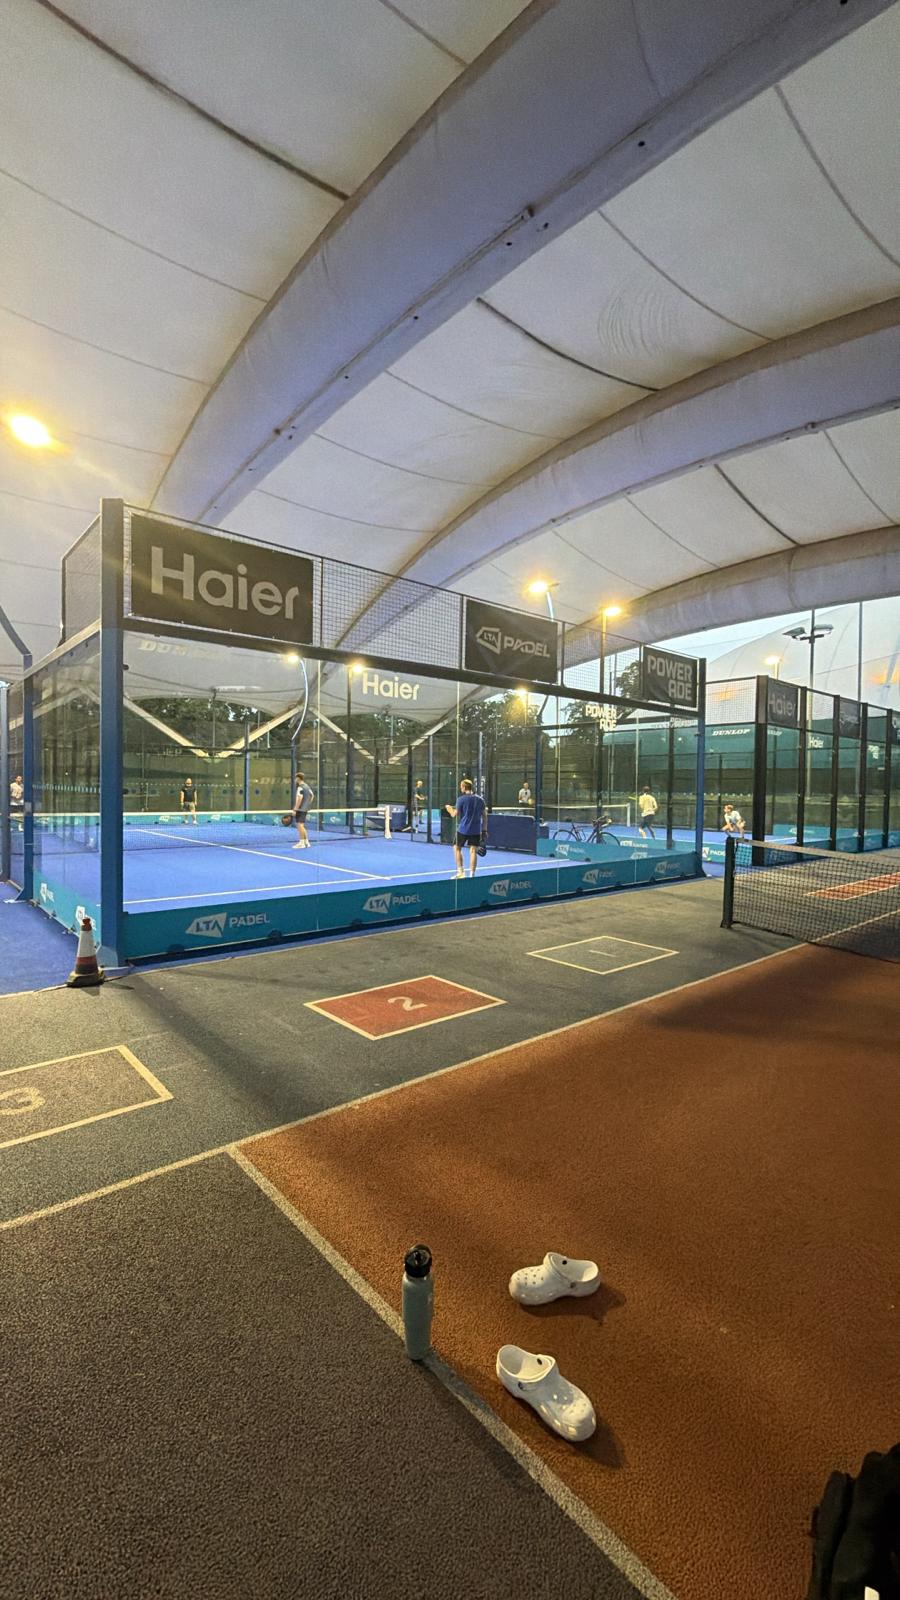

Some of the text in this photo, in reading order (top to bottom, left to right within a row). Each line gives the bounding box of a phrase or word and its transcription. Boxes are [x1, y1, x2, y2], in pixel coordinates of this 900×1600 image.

[151, 546, 299, 619] Haier
[503, 635, 551, 658] PADEL
[647, 654, 693, 681] POWER
[362, 671, 420, 701] Haier
[668, 679, 693, 700] ADE
[585, 704, 617, 720] POWER
[599, 719, 617, 731] ADE
[712, 728, 751, 737] DUNLOP
[392, 894, 422, 905] PADEL
[229, 912, 271, 928] PADEL
[387, 996, 428, 1011] 2
